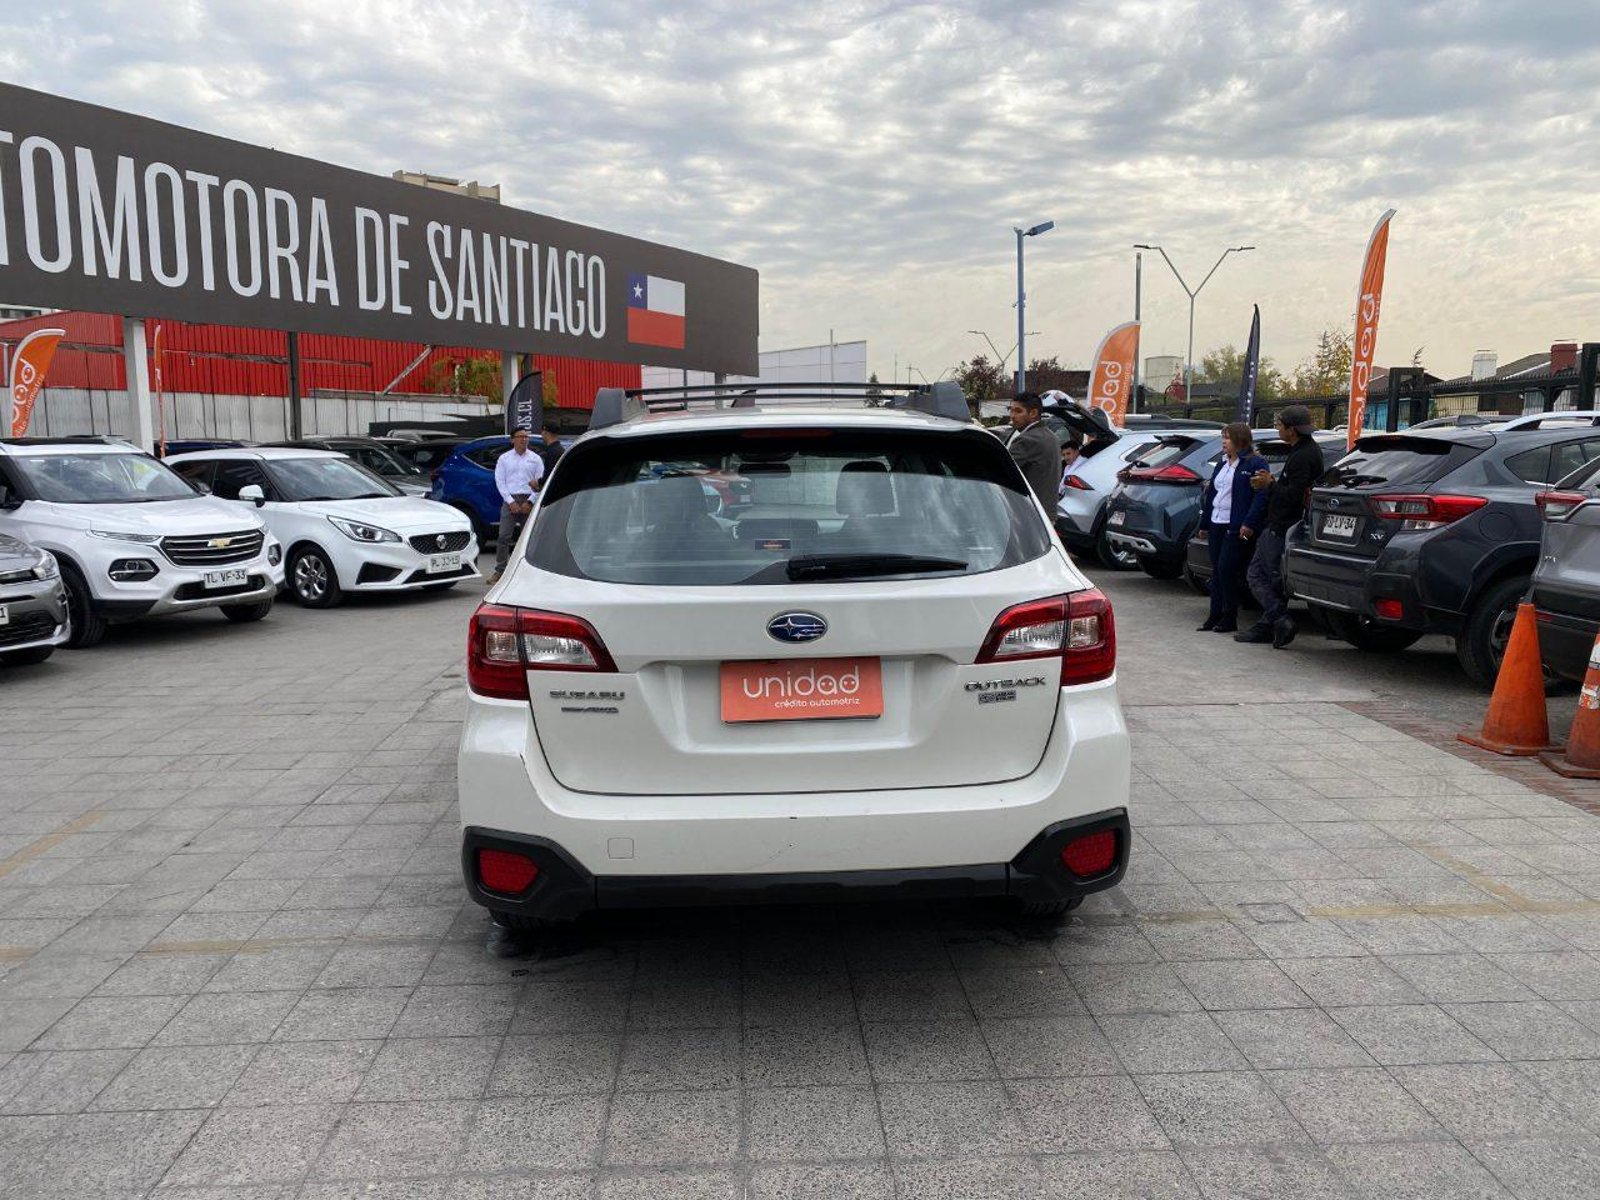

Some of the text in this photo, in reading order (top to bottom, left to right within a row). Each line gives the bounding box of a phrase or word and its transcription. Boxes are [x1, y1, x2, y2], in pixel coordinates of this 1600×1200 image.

[355, 206, 412, 315] DE
[427, 220, 607, 340] SANTIAGO
[204, 573, 218, 583] TL
[743, 665, 860, 698] unidad
[964, 676, 1047, 692] OUTBACK
[549, 690, 626, 700] SUBARU
[774, 697, 861, 708] crédito automotriz
